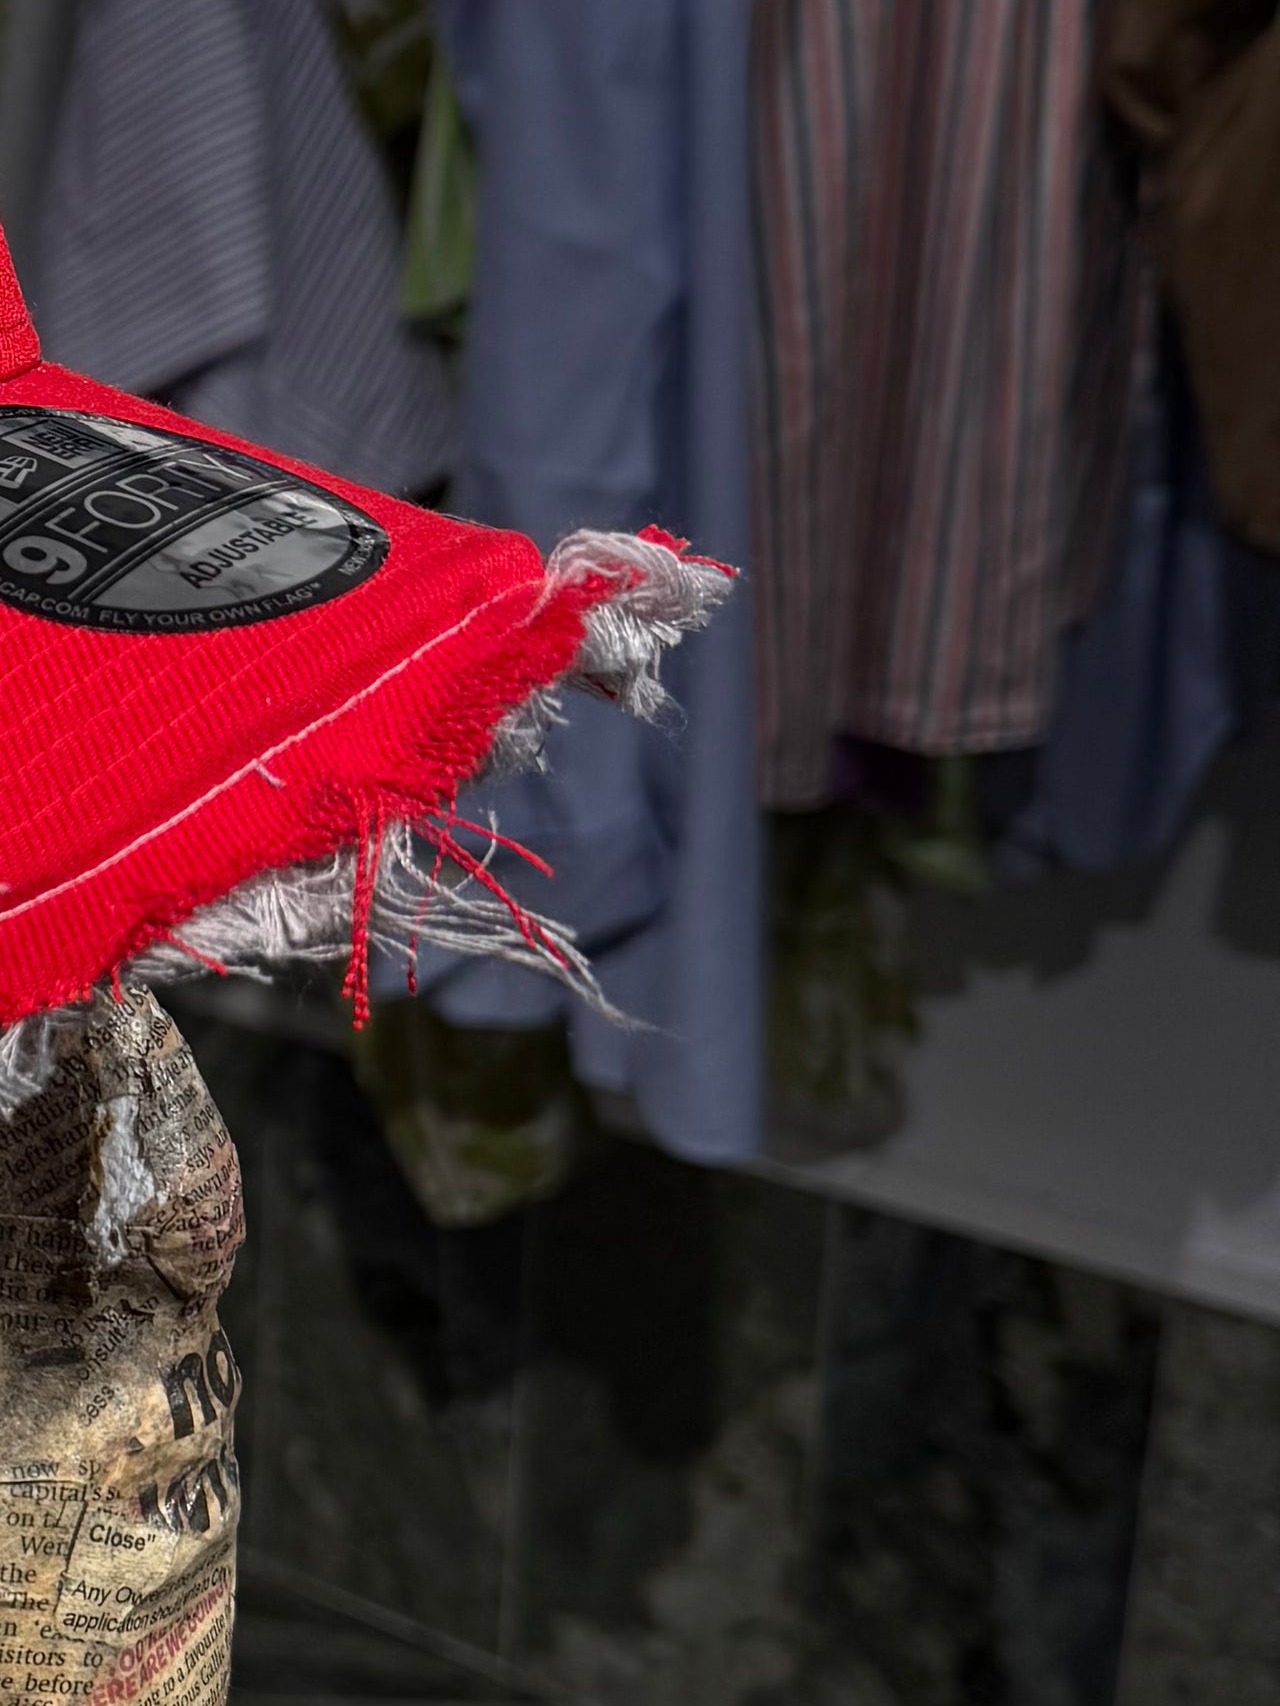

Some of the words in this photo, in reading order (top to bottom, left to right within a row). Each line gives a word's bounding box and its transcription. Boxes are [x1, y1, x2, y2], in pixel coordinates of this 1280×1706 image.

[1, 453, 253, 587] 9FORTY
[178, 509, 319, 590] ADJUSTABLE
[99, 609, 139, 626] FLY
[142, 610, 207, 626] YOUR
[209, 603, 262, 622] OWN
[5, 1509, 35, 1529] on
[71, 1581, 112, 1606] Any
[61, 1609, 151, 1635] application
[82, 1650, 104, 1669] to
[183, 1617, 228, 1676] favourite
[24, 1670, 95, 1696] before
